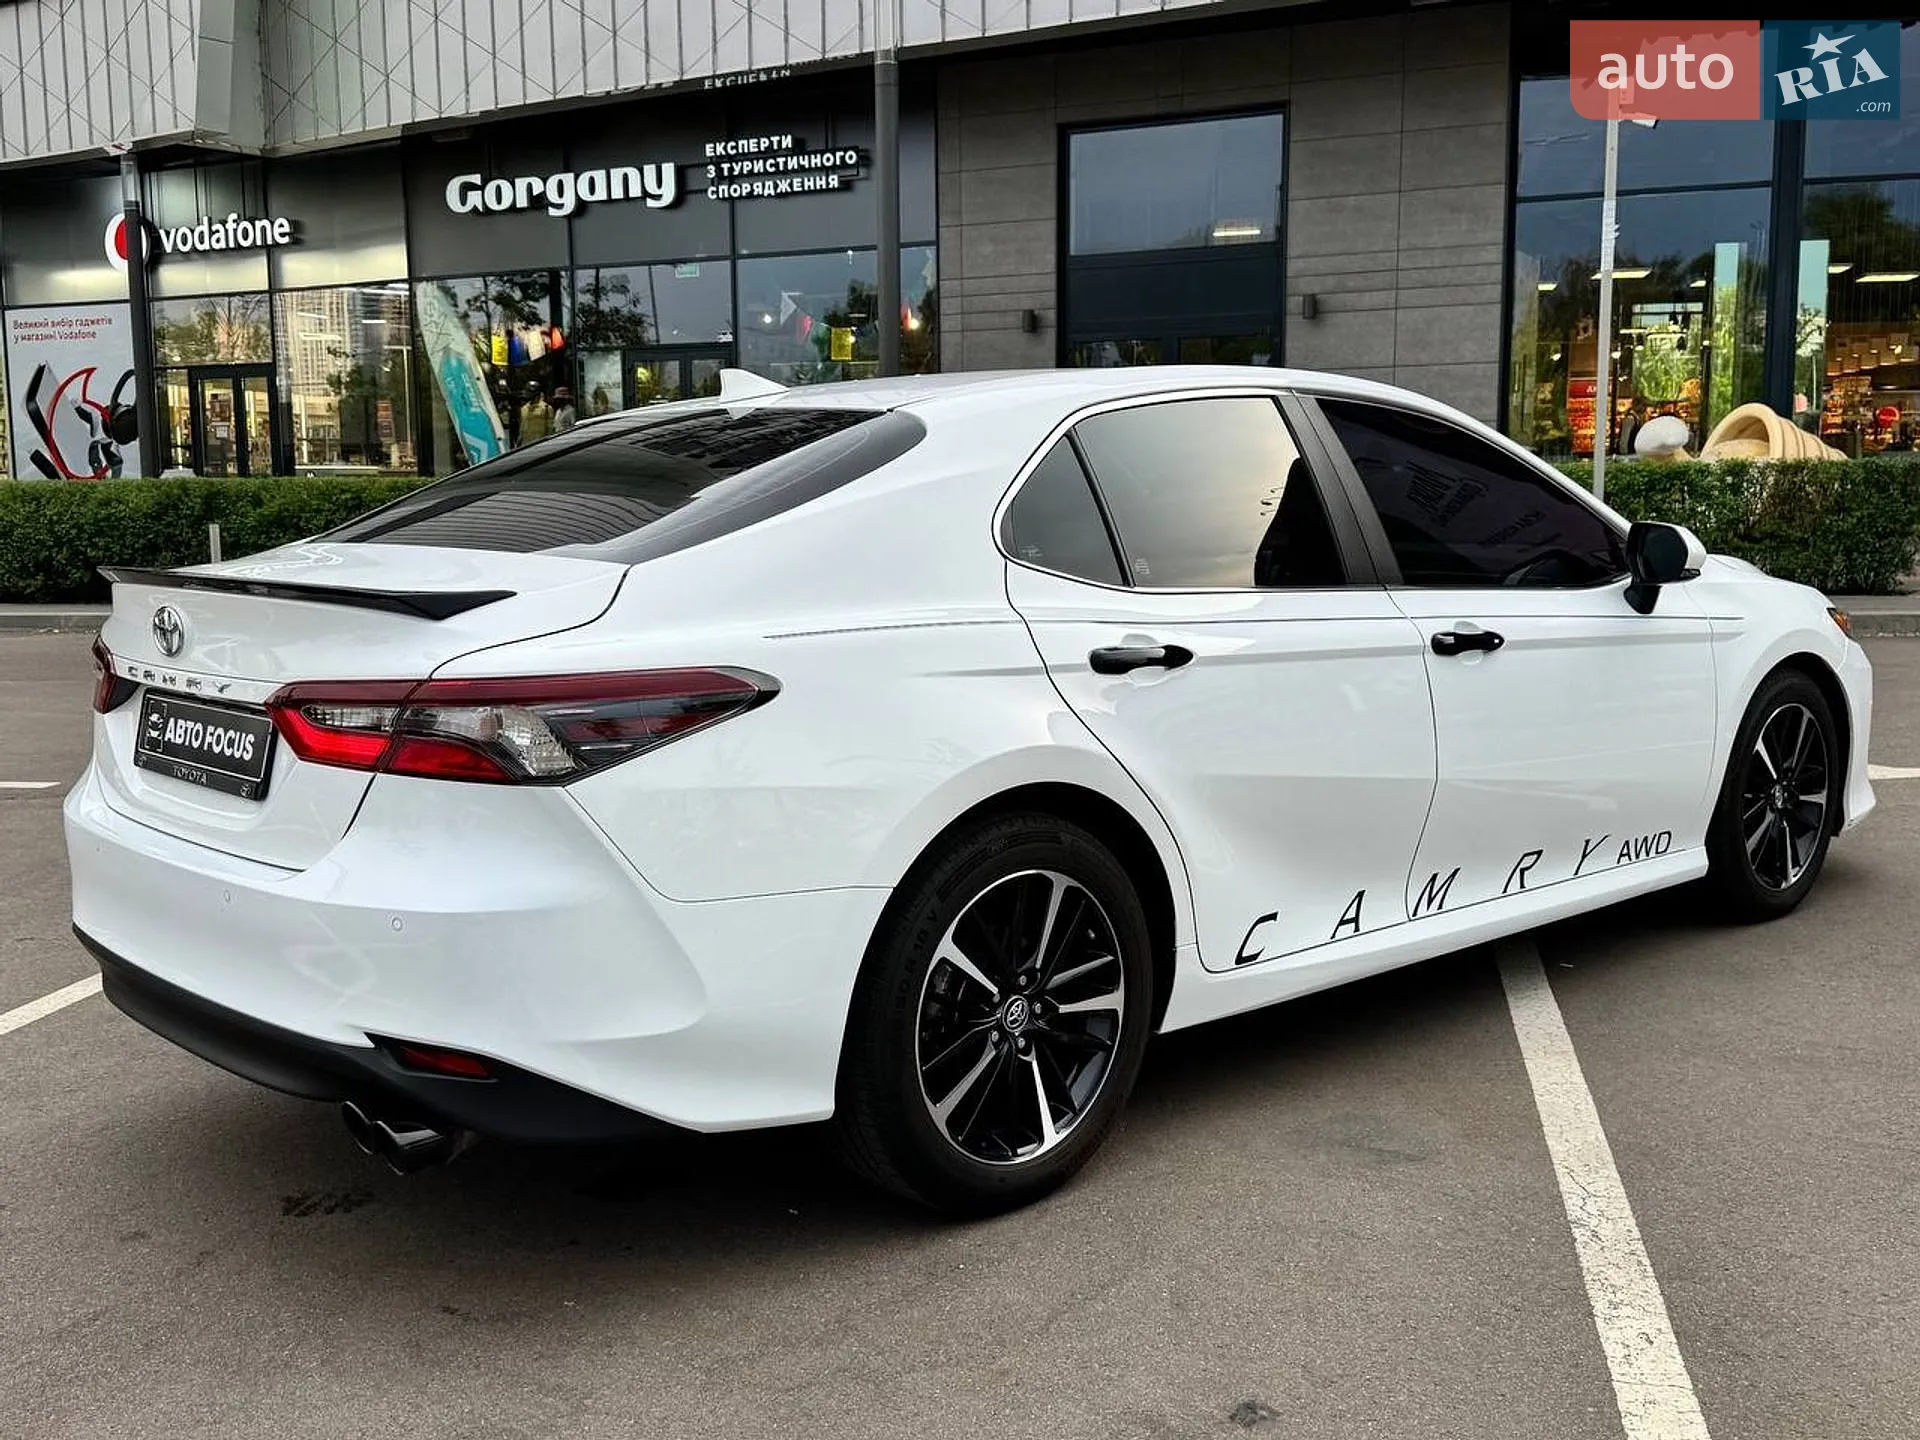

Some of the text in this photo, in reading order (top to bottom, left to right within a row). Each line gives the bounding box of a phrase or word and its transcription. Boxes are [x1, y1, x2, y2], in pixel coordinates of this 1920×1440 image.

[705, 134, 792, 157] ЕКСПЕРТИ
[721, 151, 858, 177] ТУРИСТИЧНОГО
[445, 162, 675, 216] Gorgany
[707, 175, 839, 200] СПОРЯДЖЕННЯ
[160, 212, 291, 254] vodafone
[58, 329, 97, 341] Vodafone
[203, 725, 255, 761] FOCUS
[172, 766, 208, 785] TOYOTA
[1617, 830, 1672, 864] AWD
